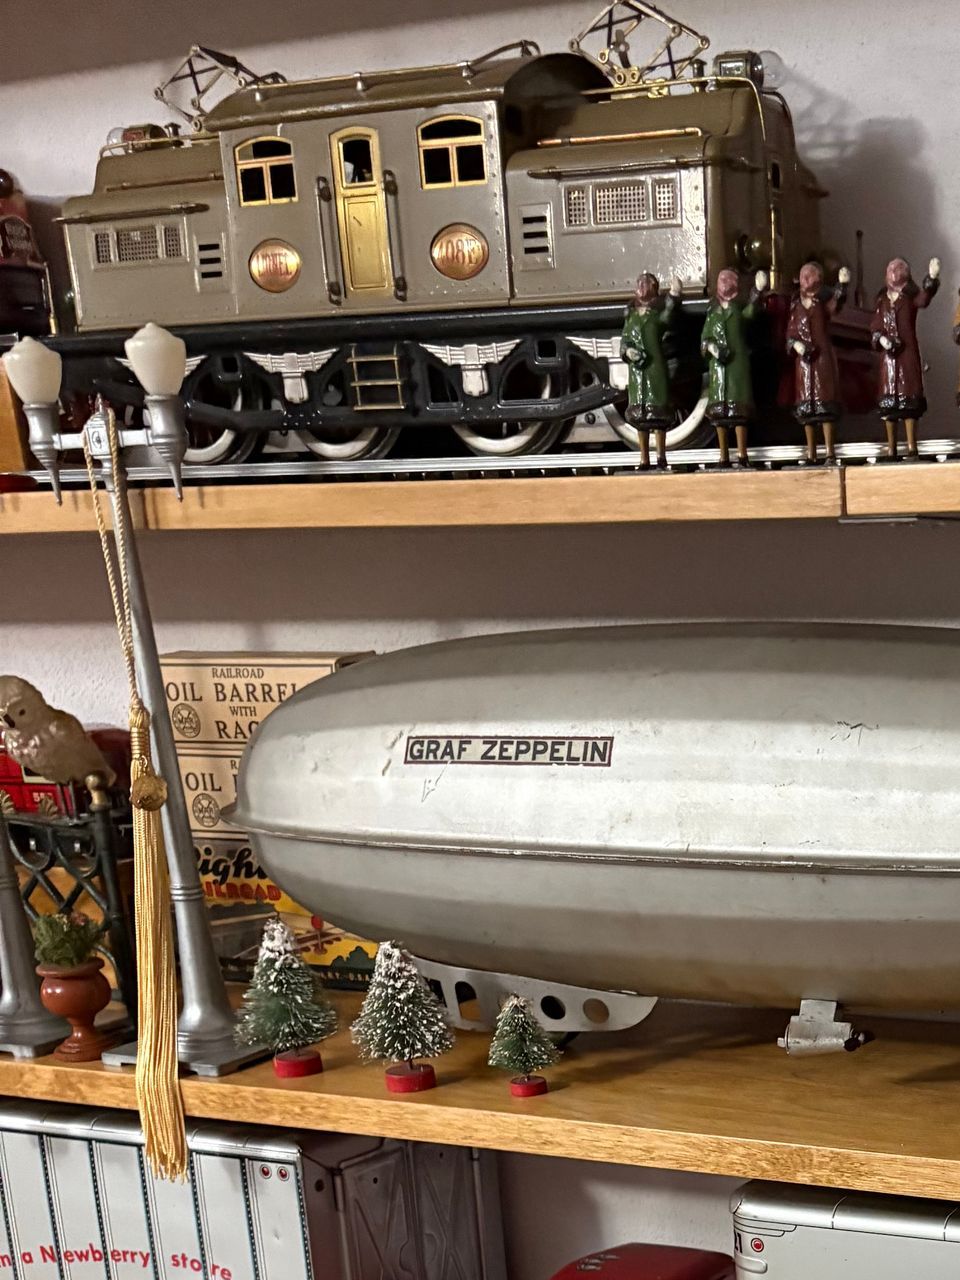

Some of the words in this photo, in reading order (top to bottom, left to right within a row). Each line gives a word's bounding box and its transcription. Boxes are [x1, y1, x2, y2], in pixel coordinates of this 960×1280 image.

[211, 667, 265, 679] RAILROAD
[166, 682, 203, 702] OIL
[229, 705, 257, 717] WITH
[409, 739, 472, 761] GRAF
[480, 739, 609, 763] ZEPPELIN
[184, 771, 222, 792] OIL
[21, 1251, 34, 1264] a
[39, 1243, 151, 1268] Newberry
